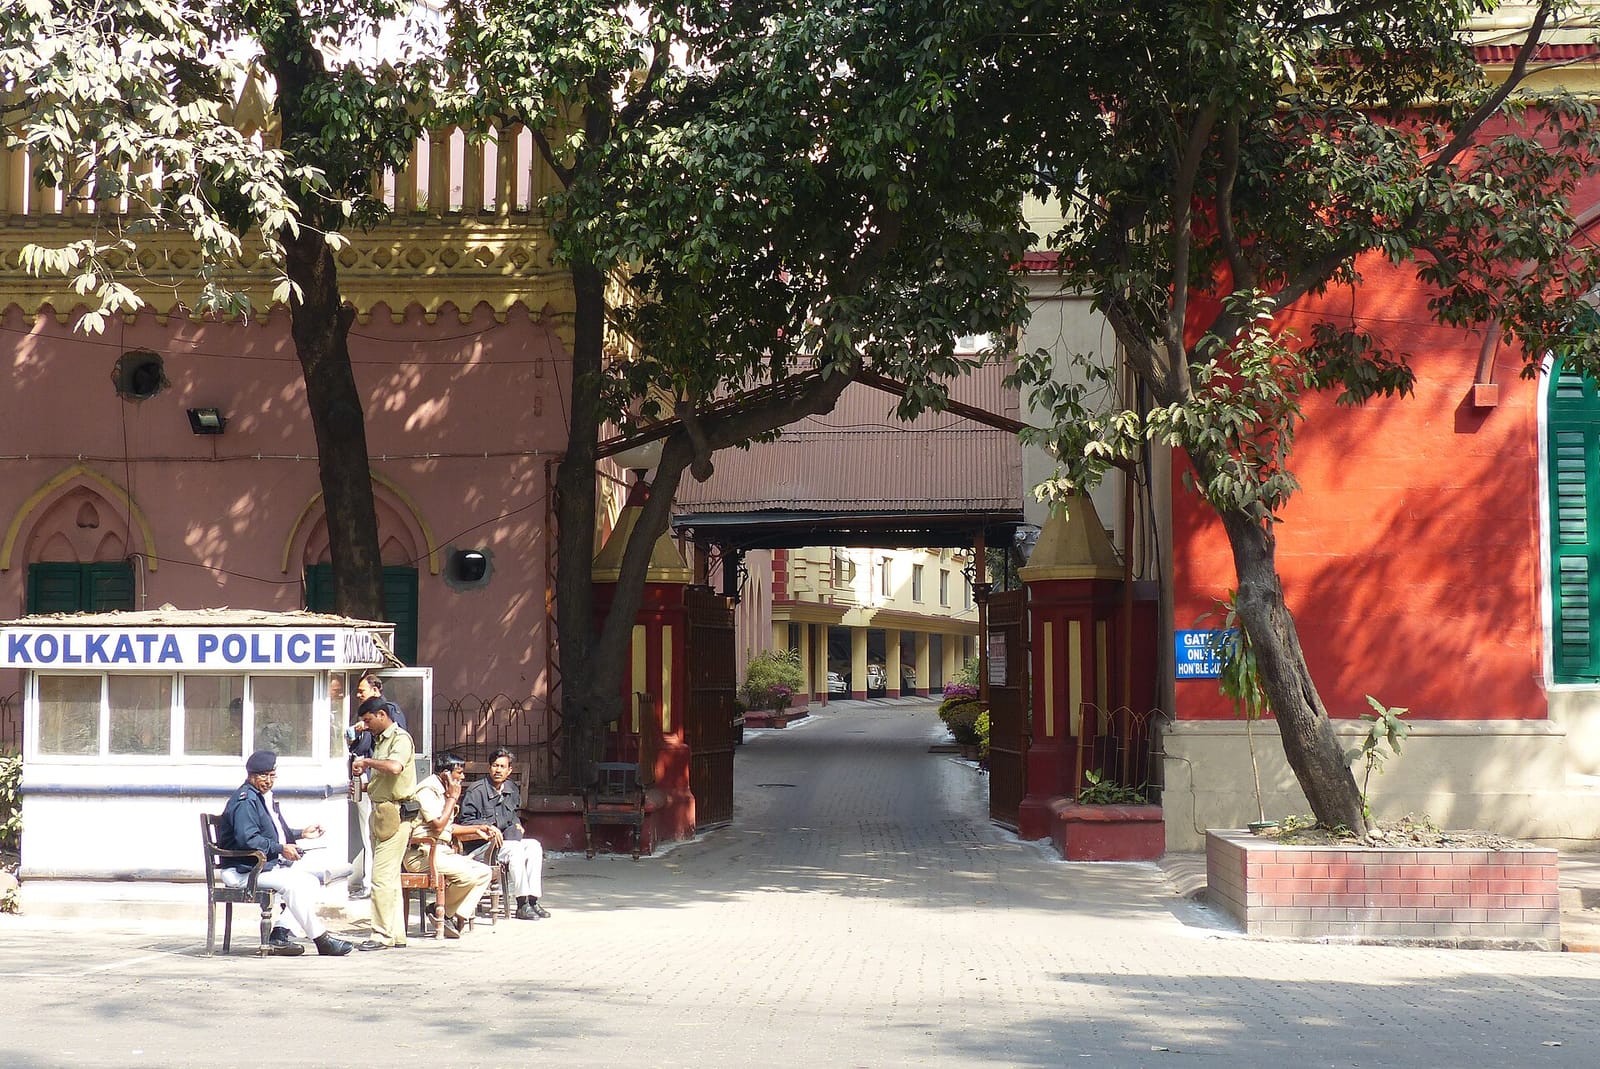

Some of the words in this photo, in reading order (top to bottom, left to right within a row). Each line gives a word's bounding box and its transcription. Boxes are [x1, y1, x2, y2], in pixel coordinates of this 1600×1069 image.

[7, 633, 183, 664] KOLKATA
[198, 633, 336, 664] POLICE
[1178, 663, 1208, 674] HON'BLE
